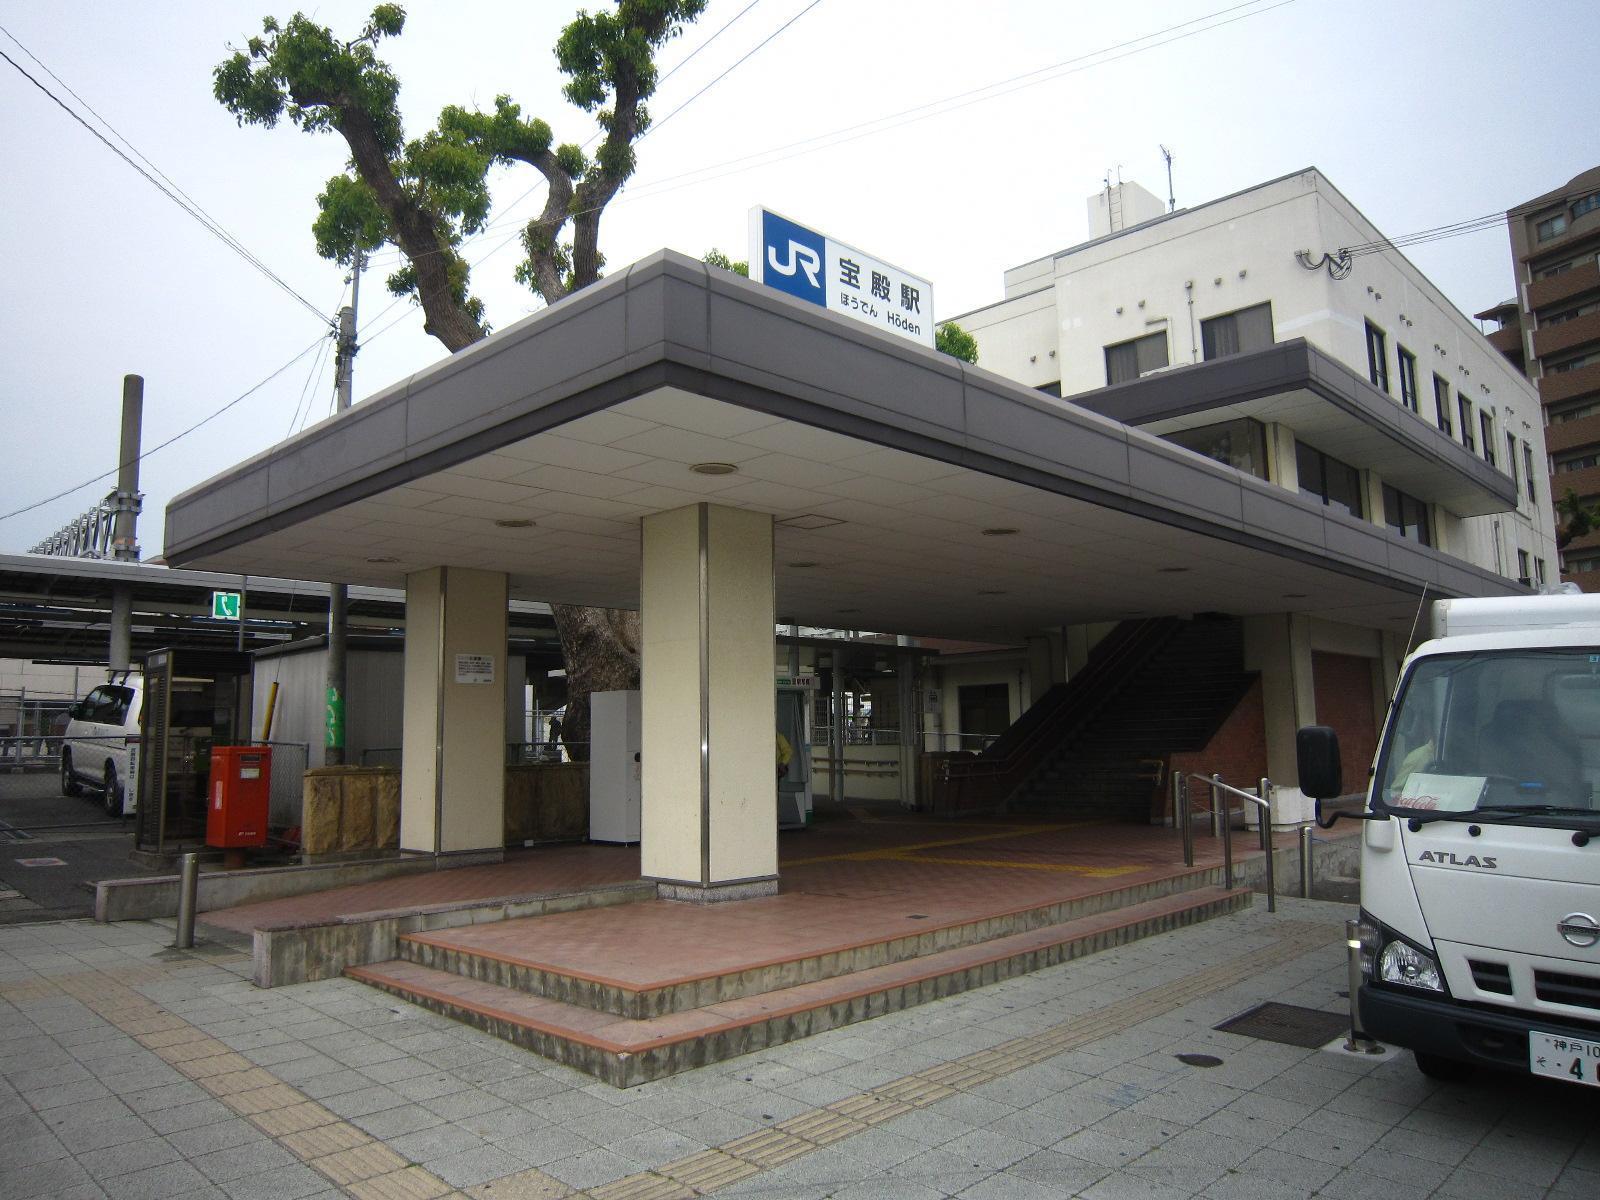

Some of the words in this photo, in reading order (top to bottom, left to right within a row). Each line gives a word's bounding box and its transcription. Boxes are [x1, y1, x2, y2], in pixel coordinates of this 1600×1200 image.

[767, 239, 821, 289] JR
[839, 257, 921, 315] 宝殿駅
[840, 291, 879, 318] ほうでん
[887, 311, 921, 336] Hōden
[1418, 850, 1497, 869] ATLAS
